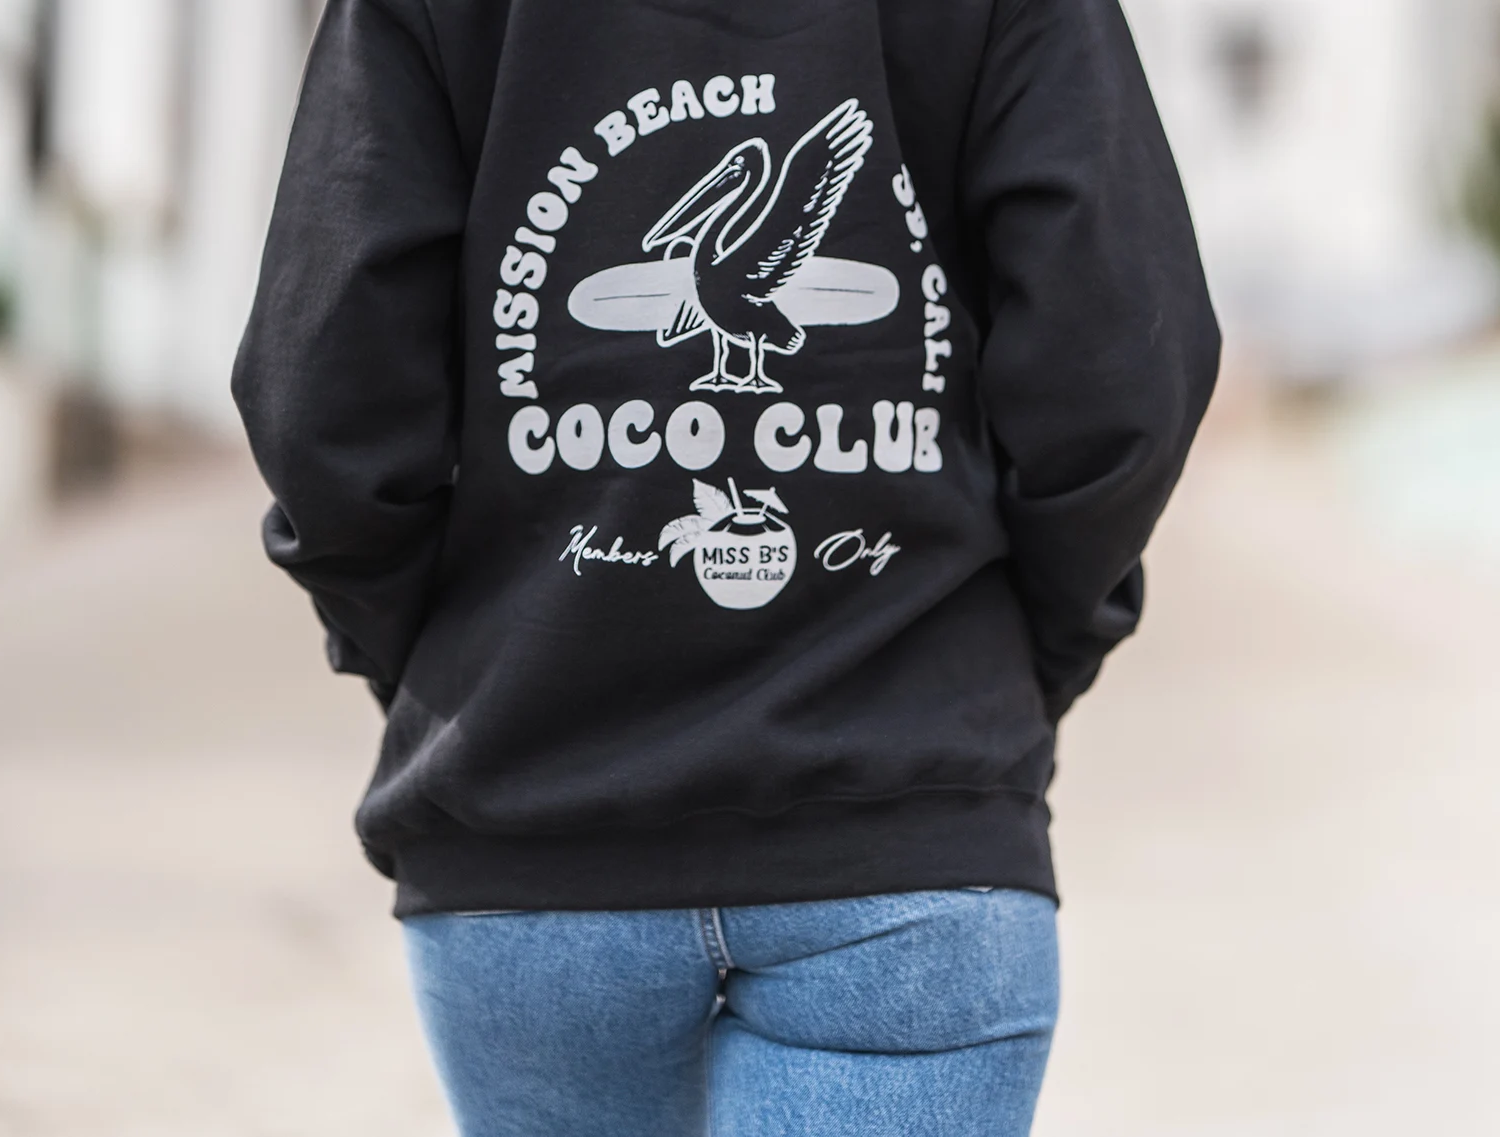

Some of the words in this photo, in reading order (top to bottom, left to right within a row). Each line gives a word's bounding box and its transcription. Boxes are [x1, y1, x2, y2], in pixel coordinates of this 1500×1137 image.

[492, 146, 599, 400] MISSION
[593, 73, 777, 157] BEACH
[921, 263, 953, 394] CALI
[507, 399, 727, 476] COCO
[753, 399, 944, 474] CLUB
[558, 524, 660, 577] Members
[813, 527, 902, 577] Only
[702, 546, 750, 565] MISS
[759, 544, 789, 564] B'S
